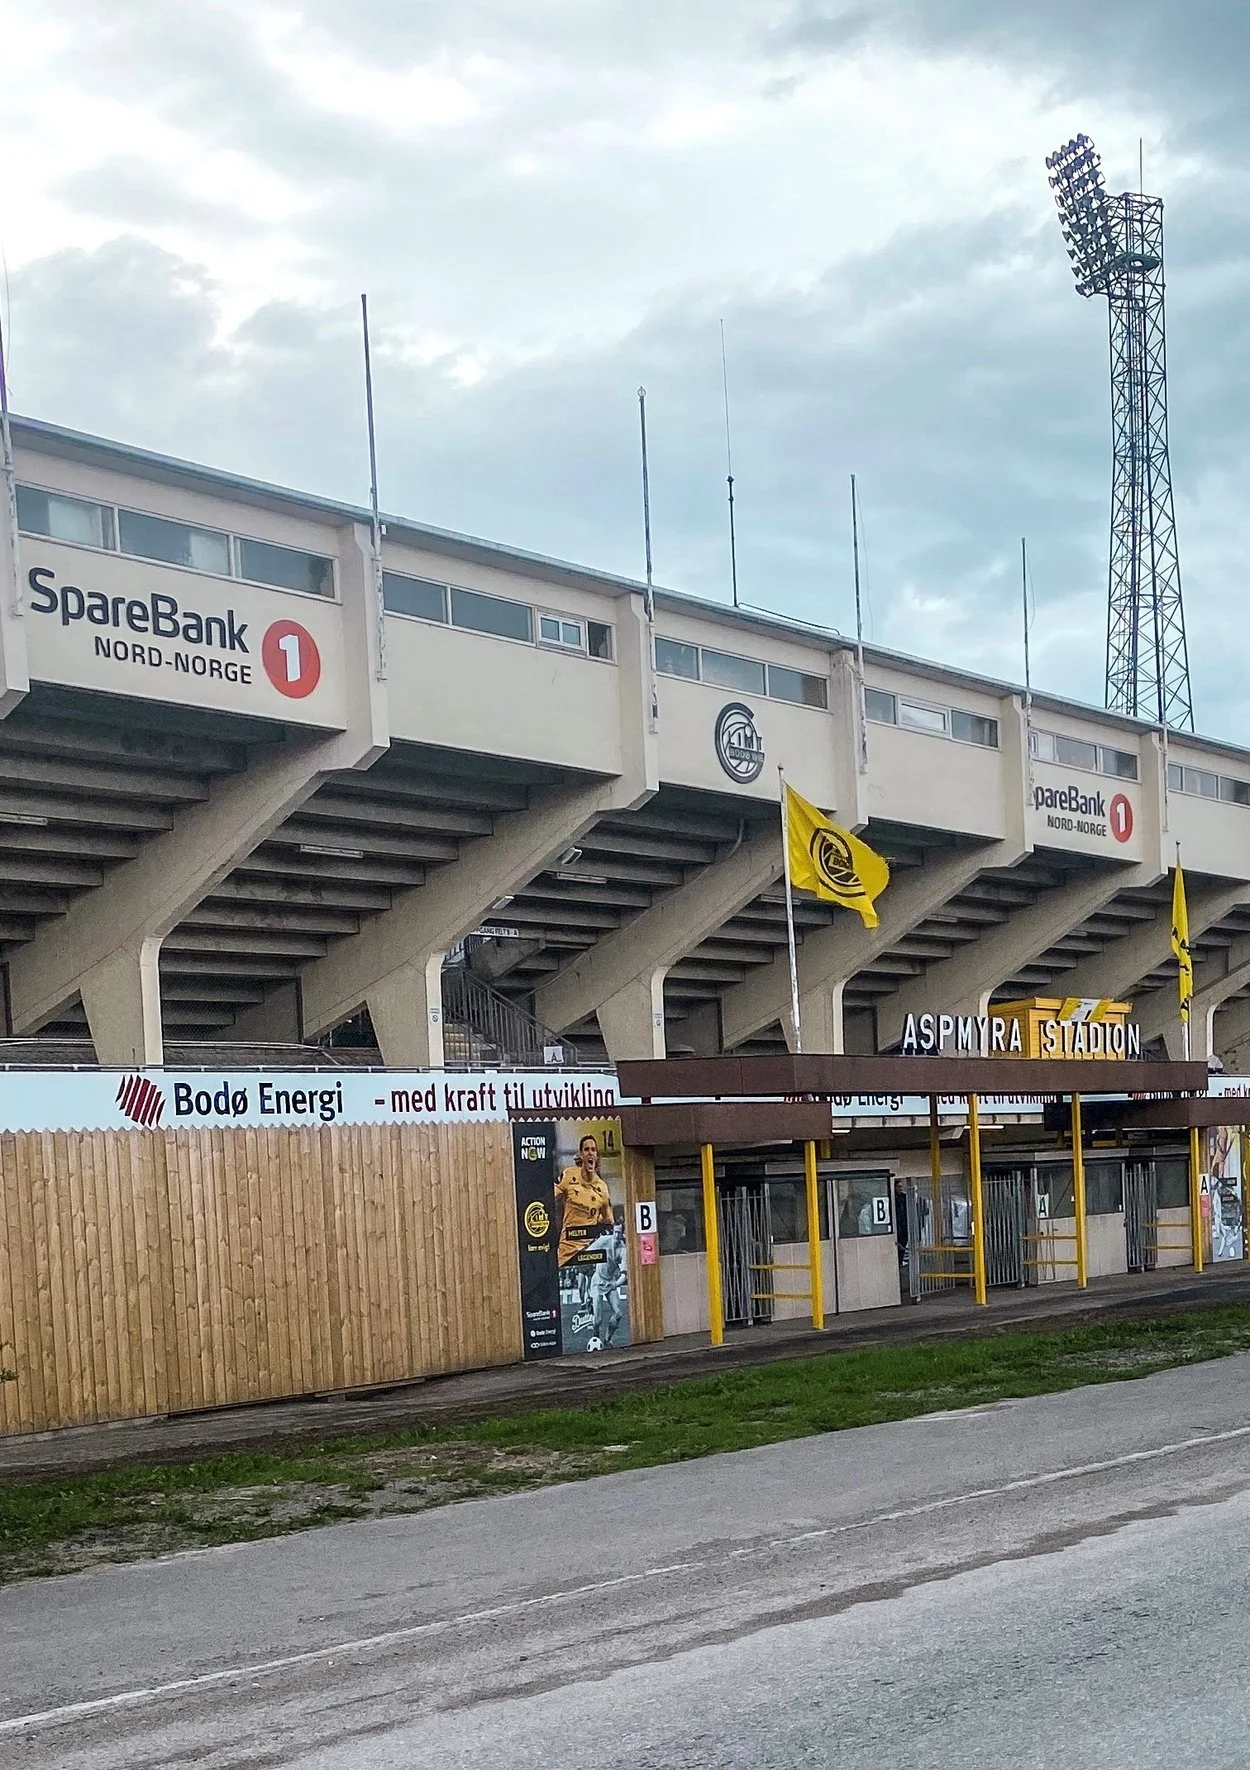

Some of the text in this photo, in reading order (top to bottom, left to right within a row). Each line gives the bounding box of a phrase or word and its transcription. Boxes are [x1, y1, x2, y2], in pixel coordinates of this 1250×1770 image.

[28, 566, 302, 682] SpareBank 1
[94, 635, 252, 684] NORD-NORGE
[1034, 785, 1126, 833] pareBank 1
[1047, 814, 1107, 837] NORD-NORGE
[902, 1013, 1141, 1056] ASPMYRA STADION
[174, 1081, 343, 1122] Bodø Energi
[391, 1082, 437, 1113] med
[444, 1082, 497, 1112] kraft
[504, 1082, 525, 1109] til
[521, 1136, 546, 1147] ACTION
[602, 1130, 614, 1152] 14
[521, 1147, 546, 1161] NOW
[1200, 1175, 1209, 1194] A
[640, 1204, 652, 1231] B
[877, 1199, 886, 1222] B
[1038, 1198, 1046, 1217] A
